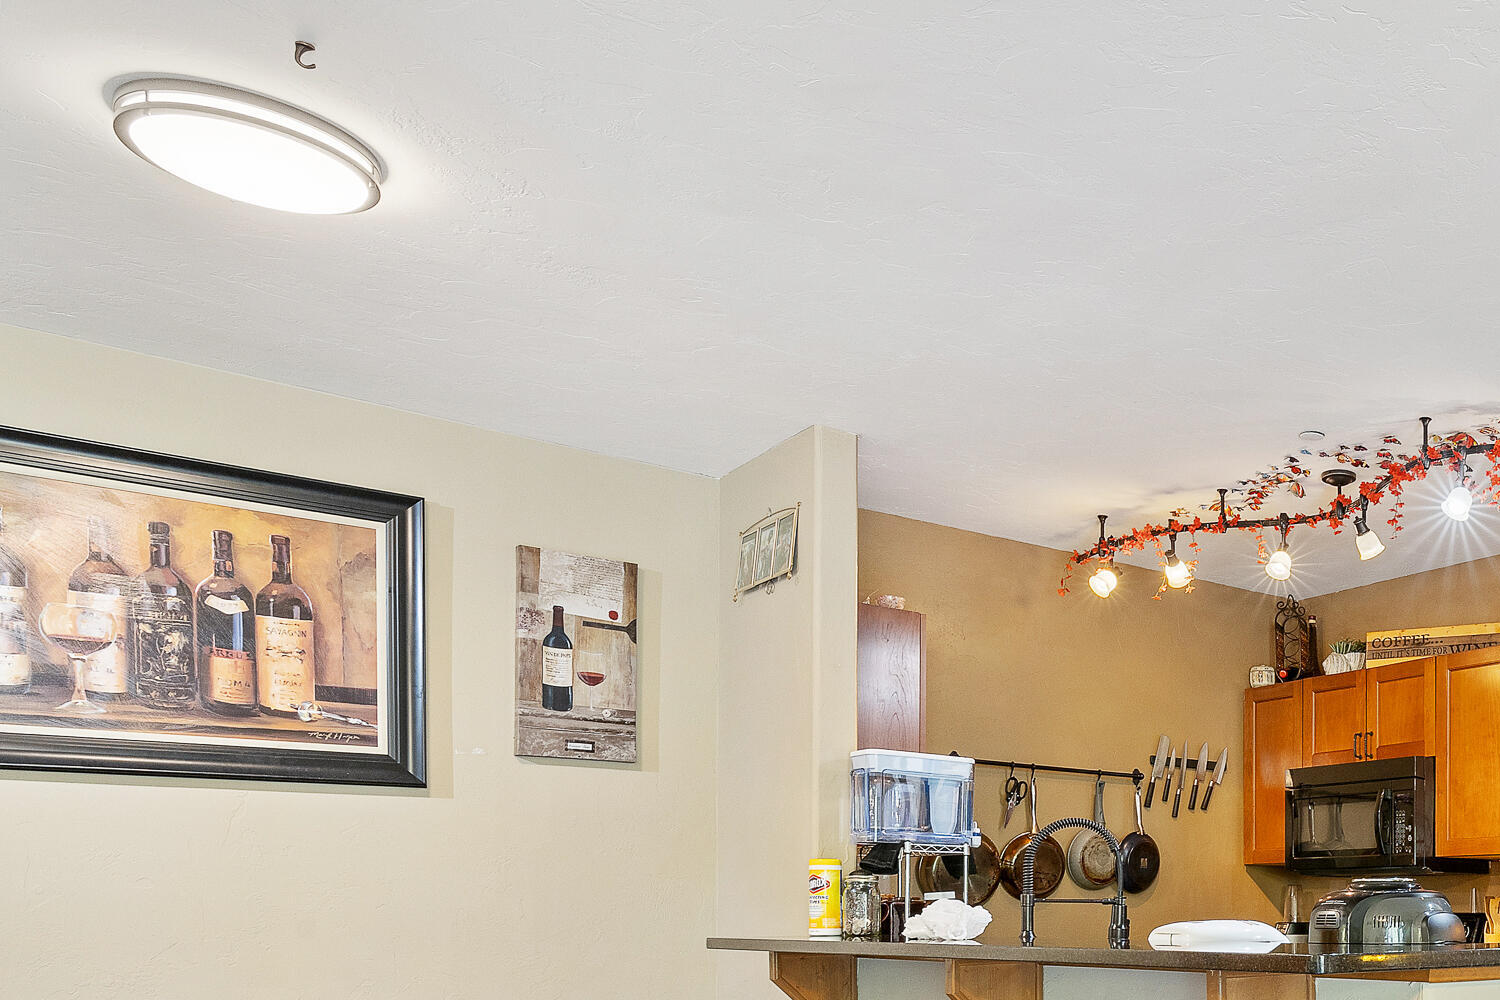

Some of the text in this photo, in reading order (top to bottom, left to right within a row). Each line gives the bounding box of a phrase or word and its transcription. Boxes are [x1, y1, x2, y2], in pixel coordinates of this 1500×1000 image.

[1372, 650, 1394, 660] UNTIL
[1396, 648, 1410, 658] IT'S
[1411, 647, 1431, 657] TIME
[1432, 646, 1448, 655] FOR
